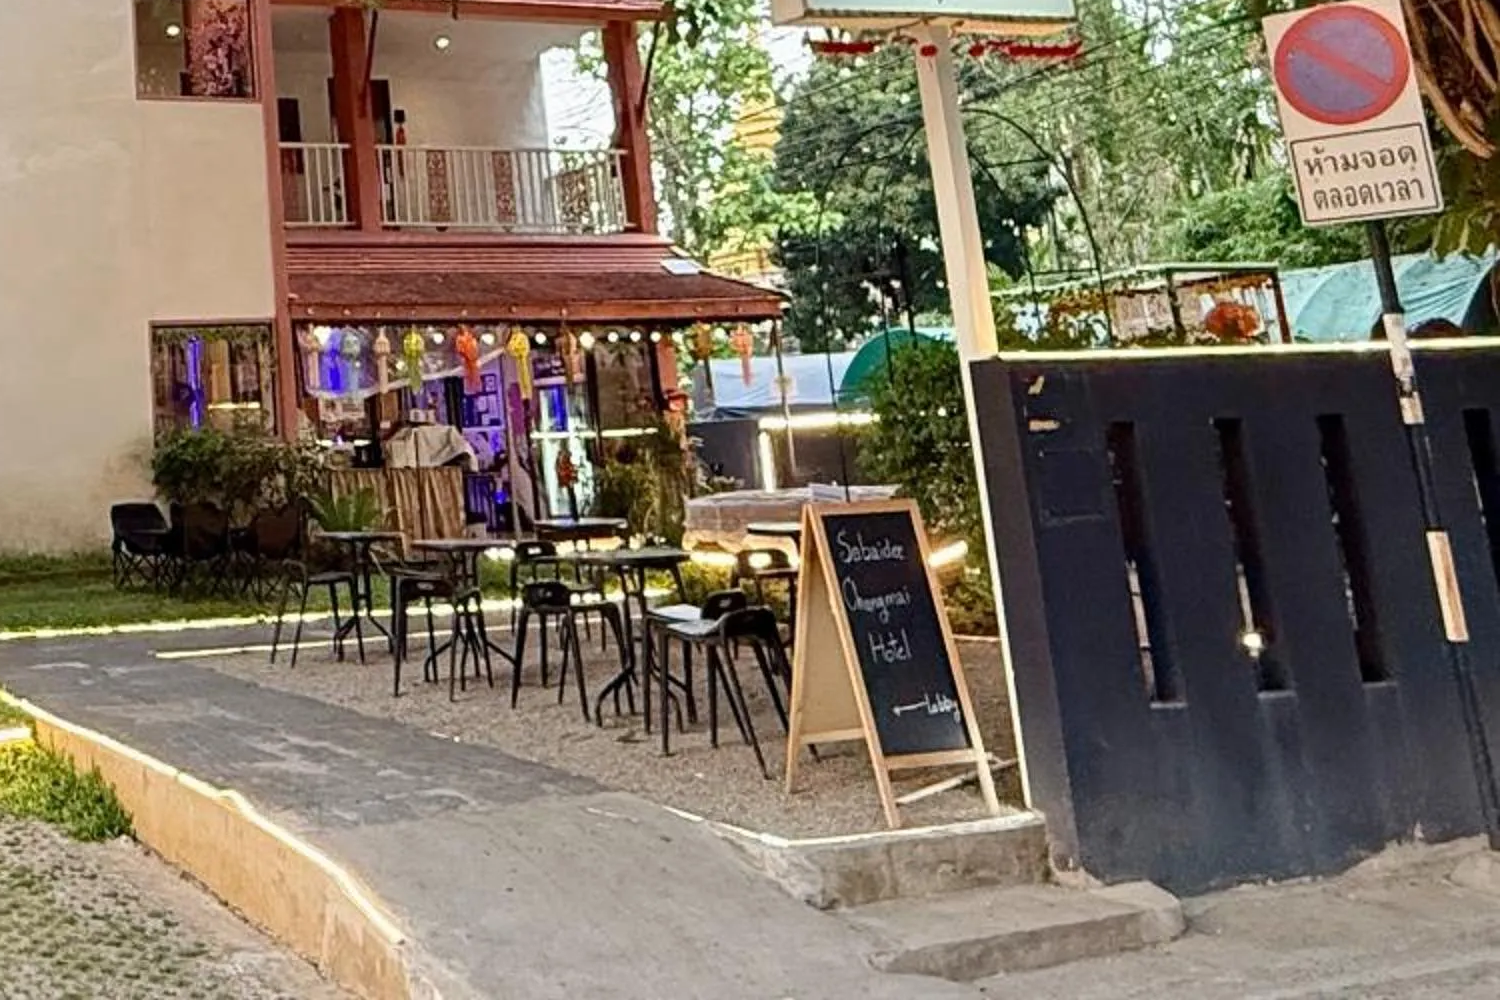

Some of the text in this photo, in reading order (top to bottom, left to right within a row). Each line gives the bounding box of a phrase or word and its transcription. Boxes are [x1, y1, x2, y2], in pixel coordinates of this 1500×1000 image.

[1304, 145, 1418, 177] ห้ามจอด
[1313, 177, 1425, 210] ตลอดเวลา
